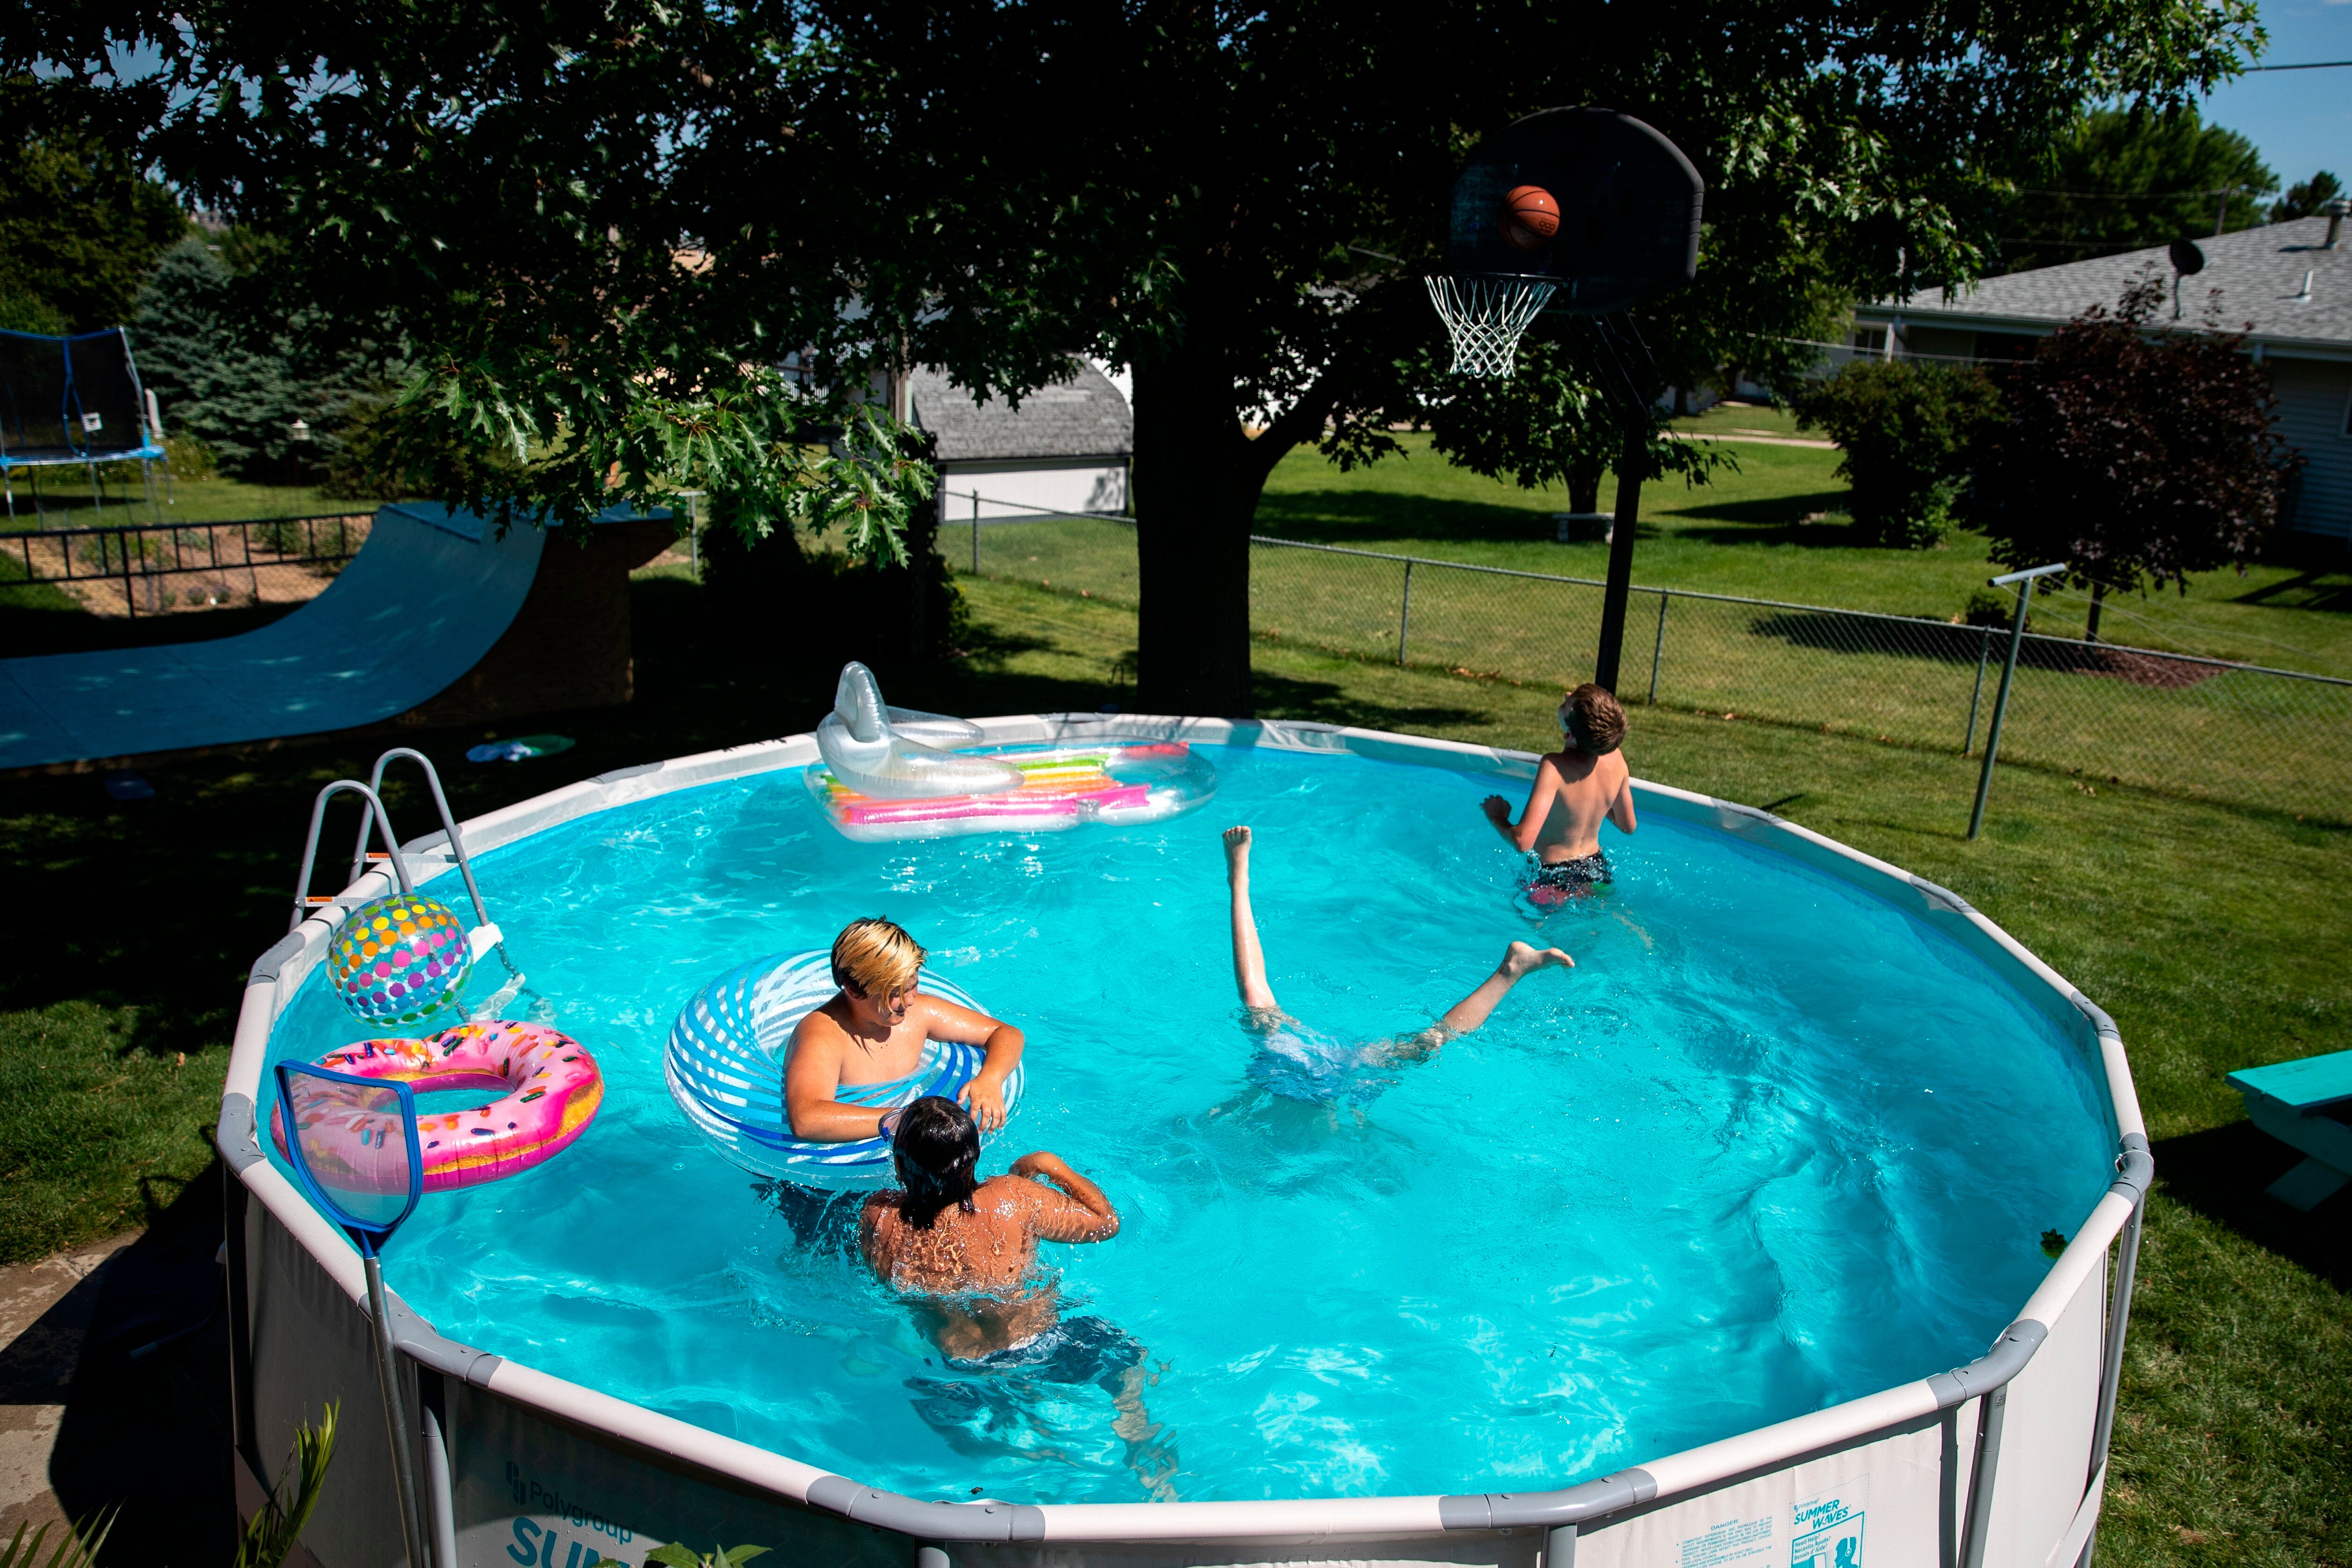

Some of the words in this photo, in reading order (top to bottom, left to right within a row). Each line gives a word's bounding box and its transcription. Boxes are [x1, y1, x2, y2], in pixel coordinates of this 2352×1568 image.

[1794, 1499, 1840, 1525] SUMMER
[1813, 1506, 1848, 1529] WAVES
[1711, 1519, 1739, 1531] DANGER:
[1795, 1539, 1807, 1547] Need
[1808, 1534, 1820, 1543] Help?
[1795, 1544, 1814, 1554] Necesita
